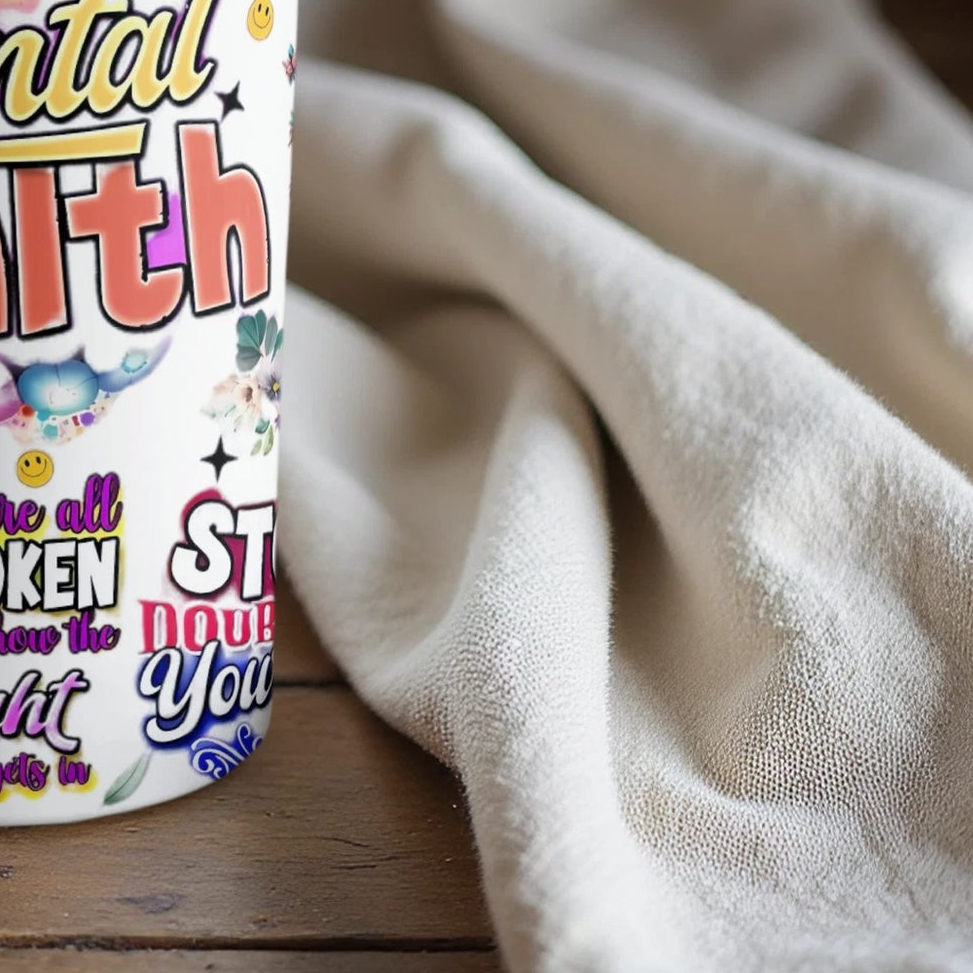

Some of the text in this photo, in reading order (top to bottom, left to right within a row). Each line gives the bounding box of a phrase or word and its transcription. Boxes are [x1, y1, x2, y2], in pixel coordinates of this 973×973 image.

[55, 471, 124, 535] all
[169, 498, 277, 602] ST
[61, 609, 121, 655] the
[138, 638, 275, 746] You
[57, 753, 92, 786] in
